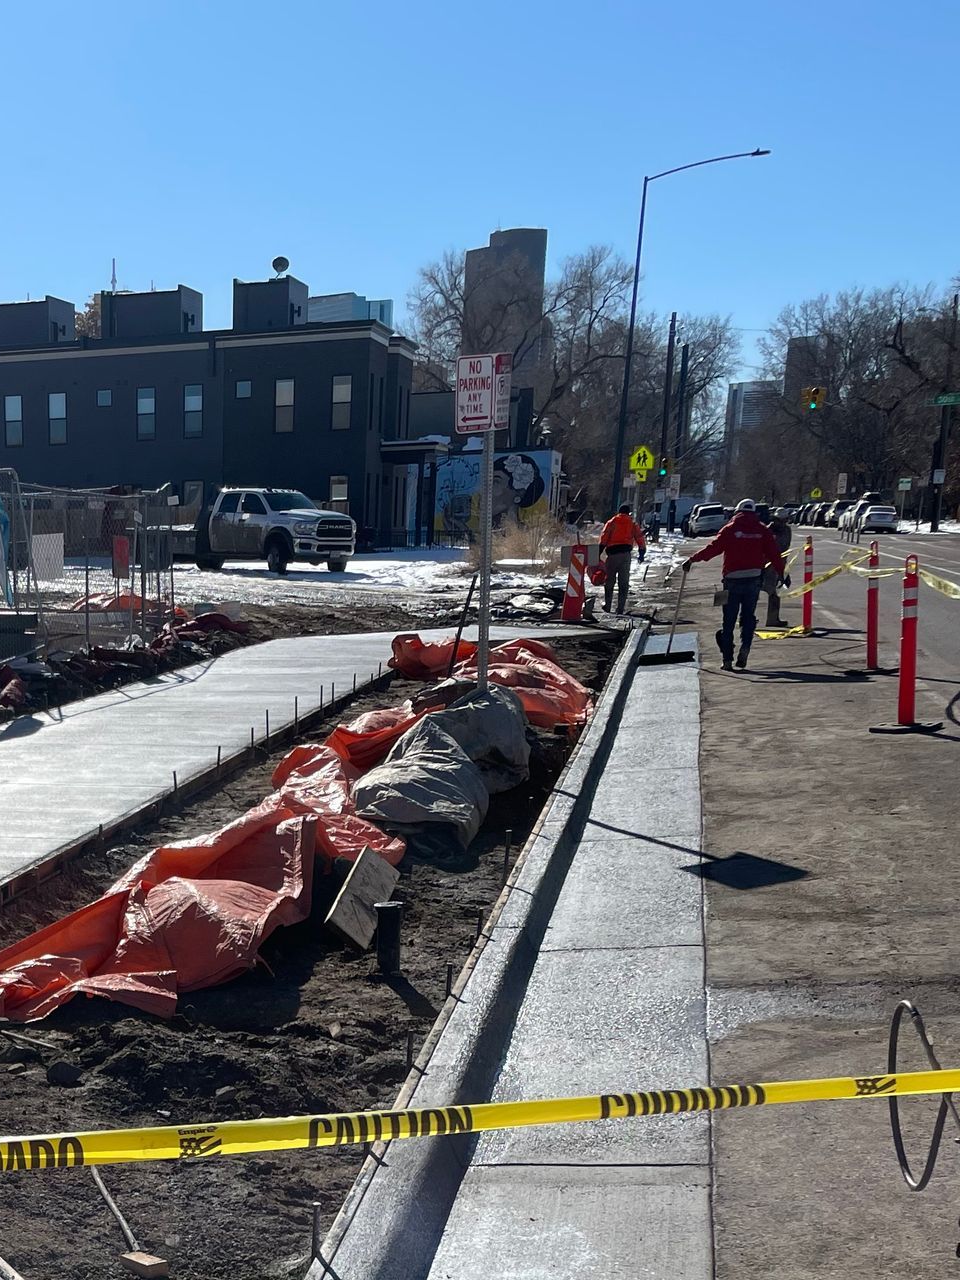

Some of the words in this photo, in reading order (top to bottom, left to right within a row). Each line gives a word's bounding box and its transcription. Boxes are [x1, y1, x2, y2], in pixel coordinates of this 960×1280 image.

[469, 361, 482, 374] NO
[460, 376, 491, 392] PARKING
[468, 393, 482, 402] ANY
[466, 404, 483, 414] TIME
[600, 1084, 766, 1119] CUIDADO
[178, 1126, 219, 1136] Empire
[308, 1106, 473, 1147] CAUTION
